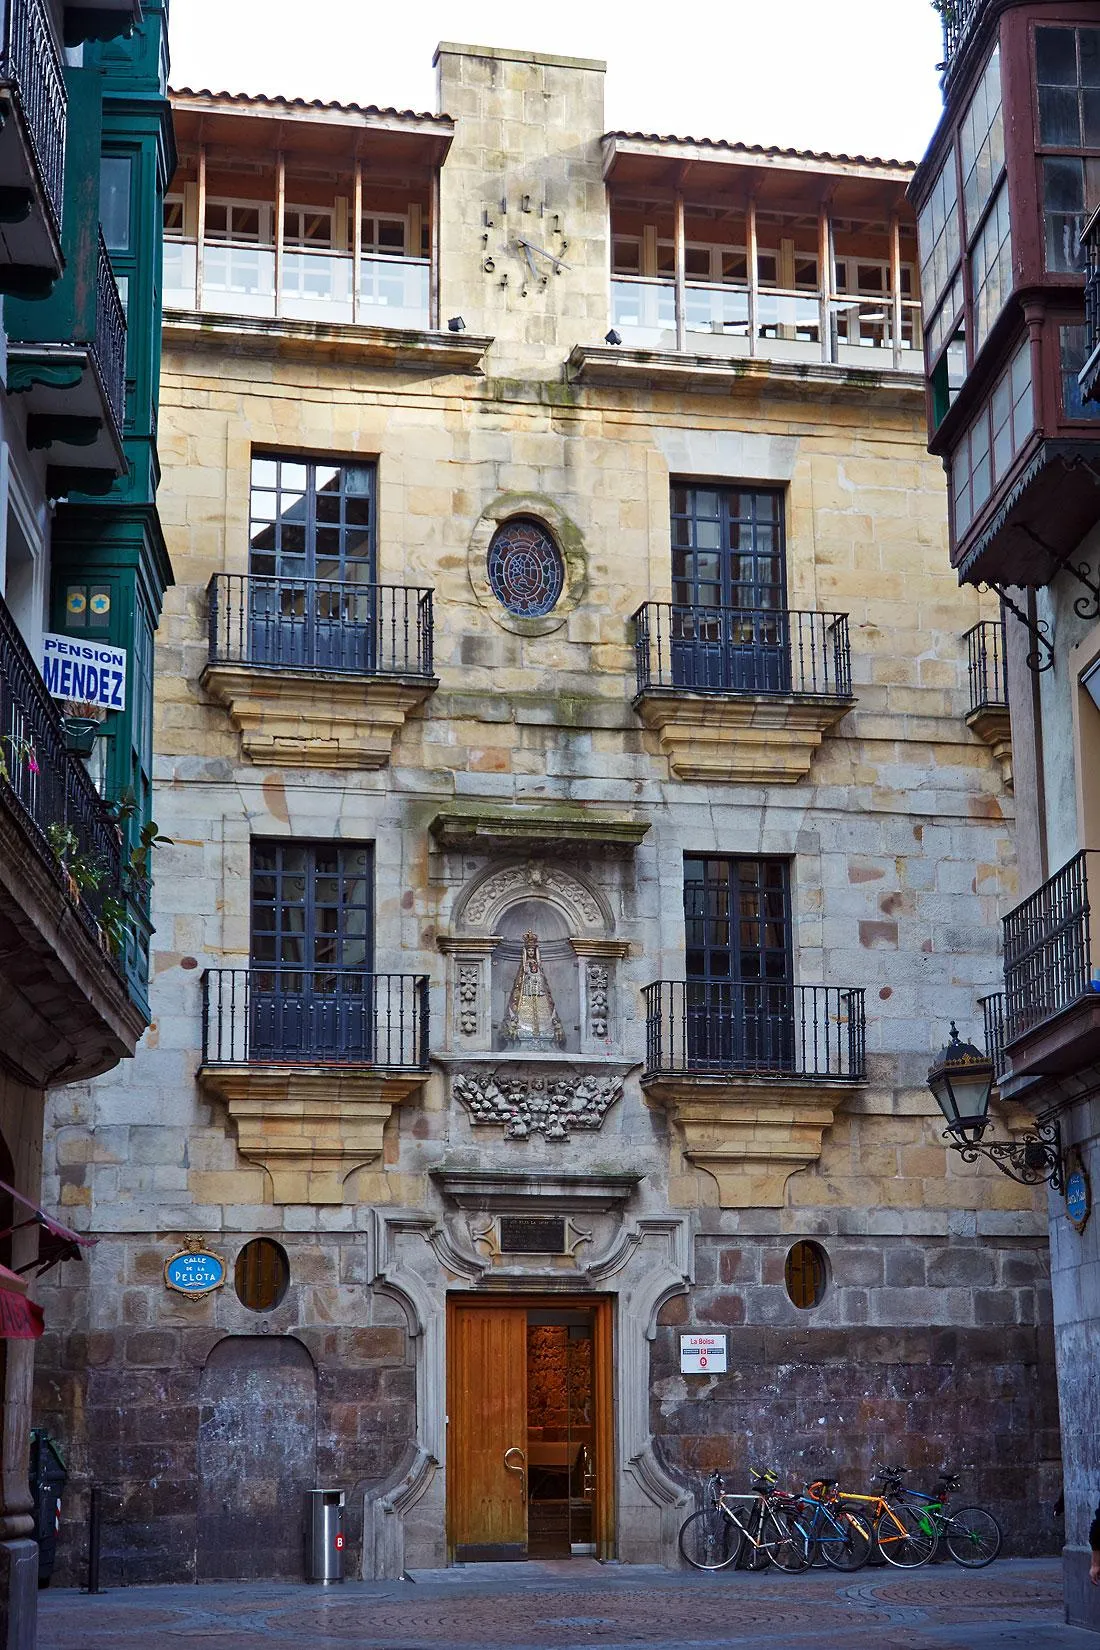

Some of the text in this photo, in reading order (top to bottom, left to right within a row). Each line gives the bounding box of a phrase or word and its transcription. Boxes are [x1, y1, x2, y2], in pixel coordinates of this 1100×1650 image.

[44, 639, 123, 667] PENSION
[44, 657, 123, 706] MENDEZ
[175, 1271, 216, 1281] PELOTA
[337, 1537, 343, 1547] B
